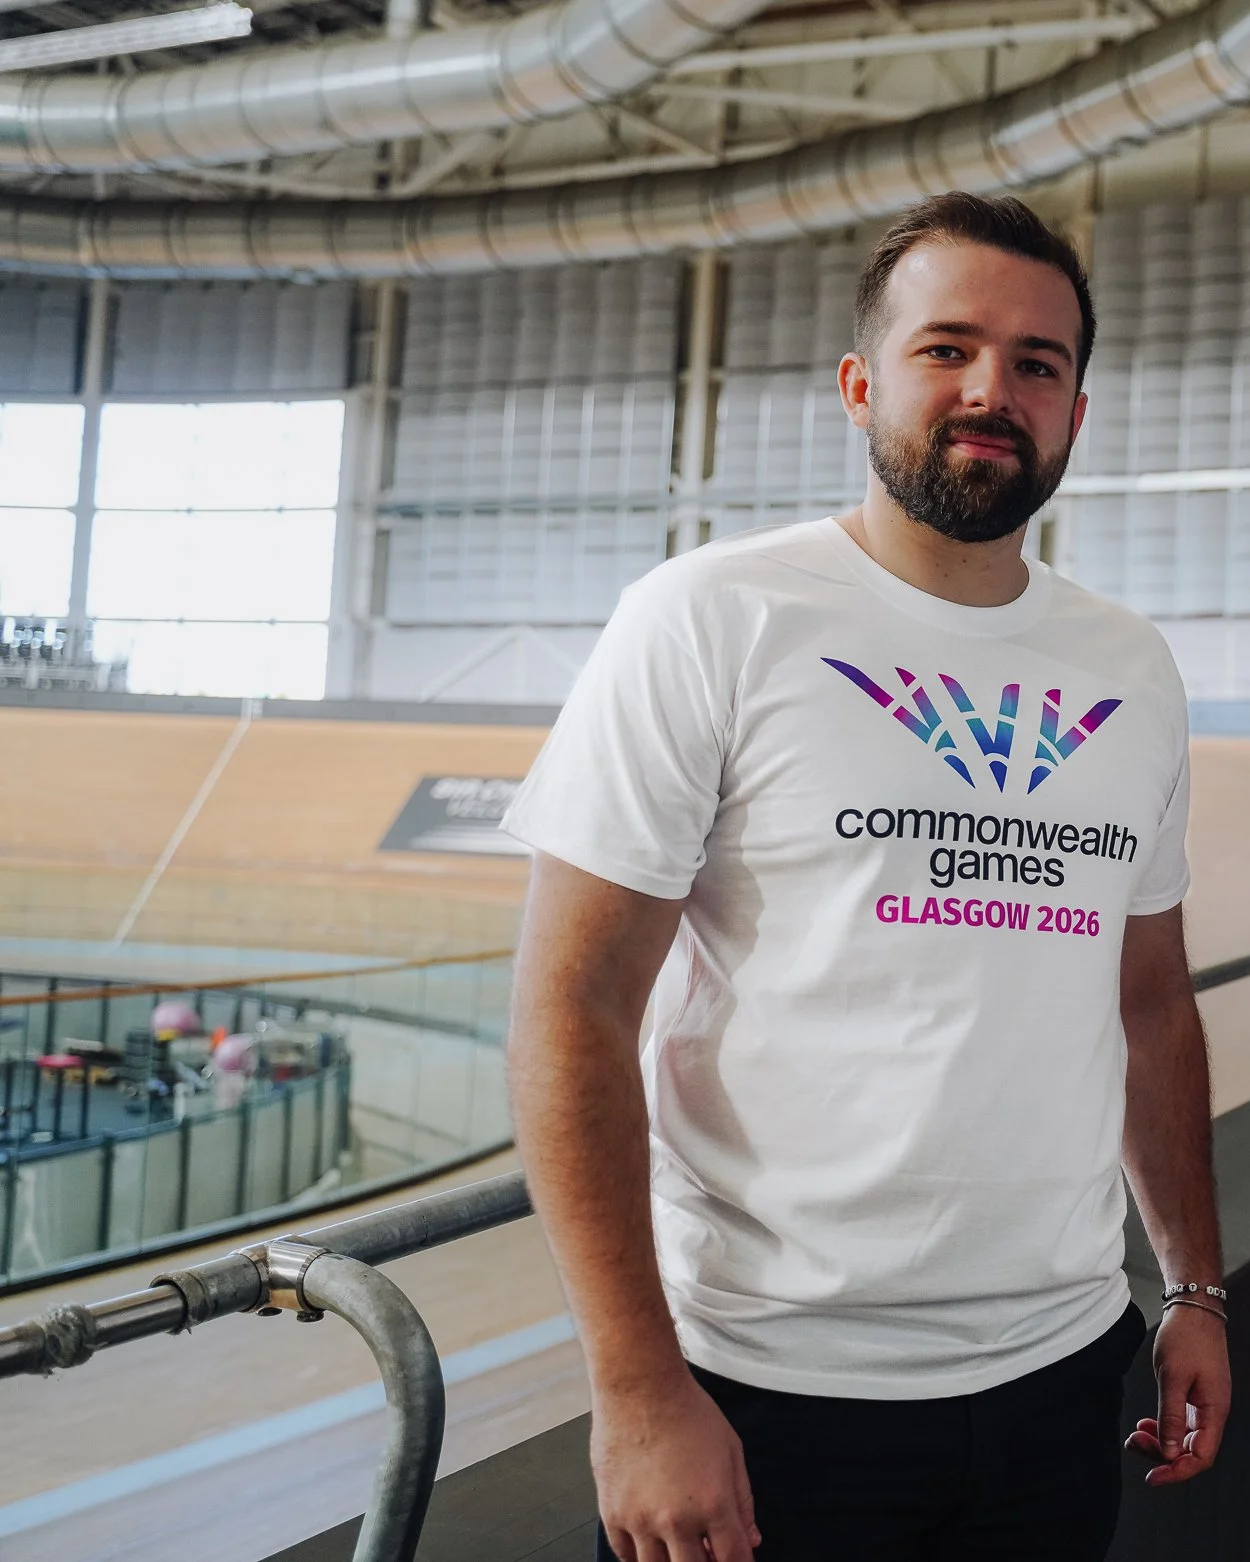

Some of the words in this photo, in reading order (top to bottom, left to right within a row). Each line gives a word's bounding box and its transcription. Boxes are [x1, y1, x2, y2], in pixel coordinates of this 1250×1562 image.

[836, 808, 1138, 862] commonwealth
[930, 847, 1065, 888] games
[876, 894, 1030, 931] GLASGOW
[1037, 905, 1100, 937] 2026
